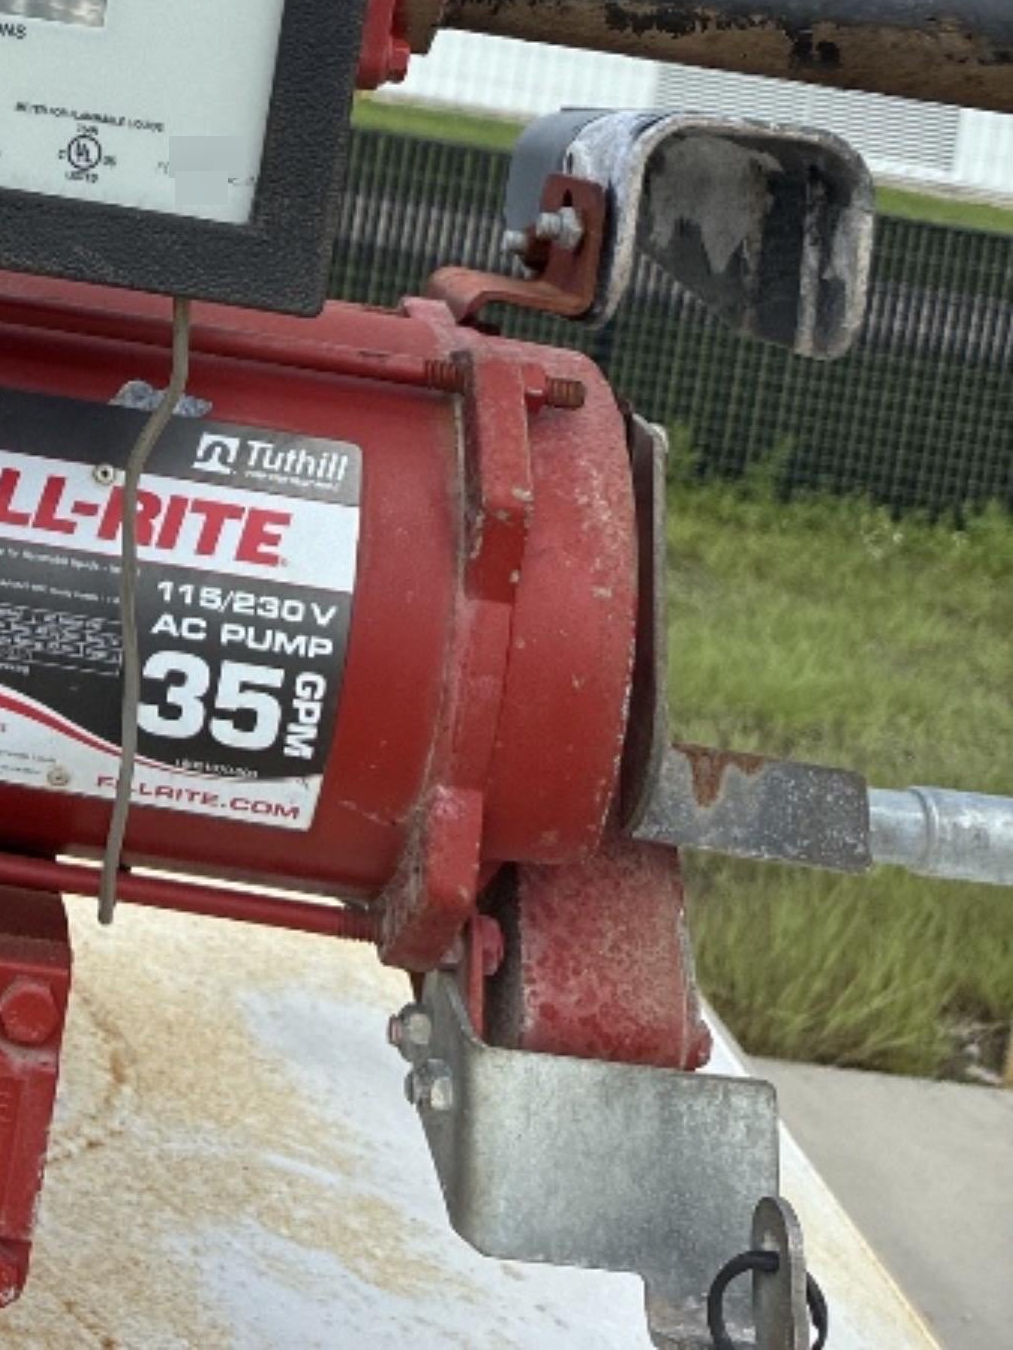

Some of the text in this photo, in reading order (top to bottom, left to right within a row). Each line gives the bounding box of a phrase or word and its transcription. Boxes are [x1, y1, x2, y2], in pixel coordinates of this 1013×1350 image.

[247, 439, 349, 482] Tuthill
[157, 580, 337, 627] 115/230 V
[150, 613, 334, 659] AC PUMP
[135, 651, 285, 751] 35
[283, 671, 327, 761] GPM
[97, 775, 301, 820] FLRITE.COM
